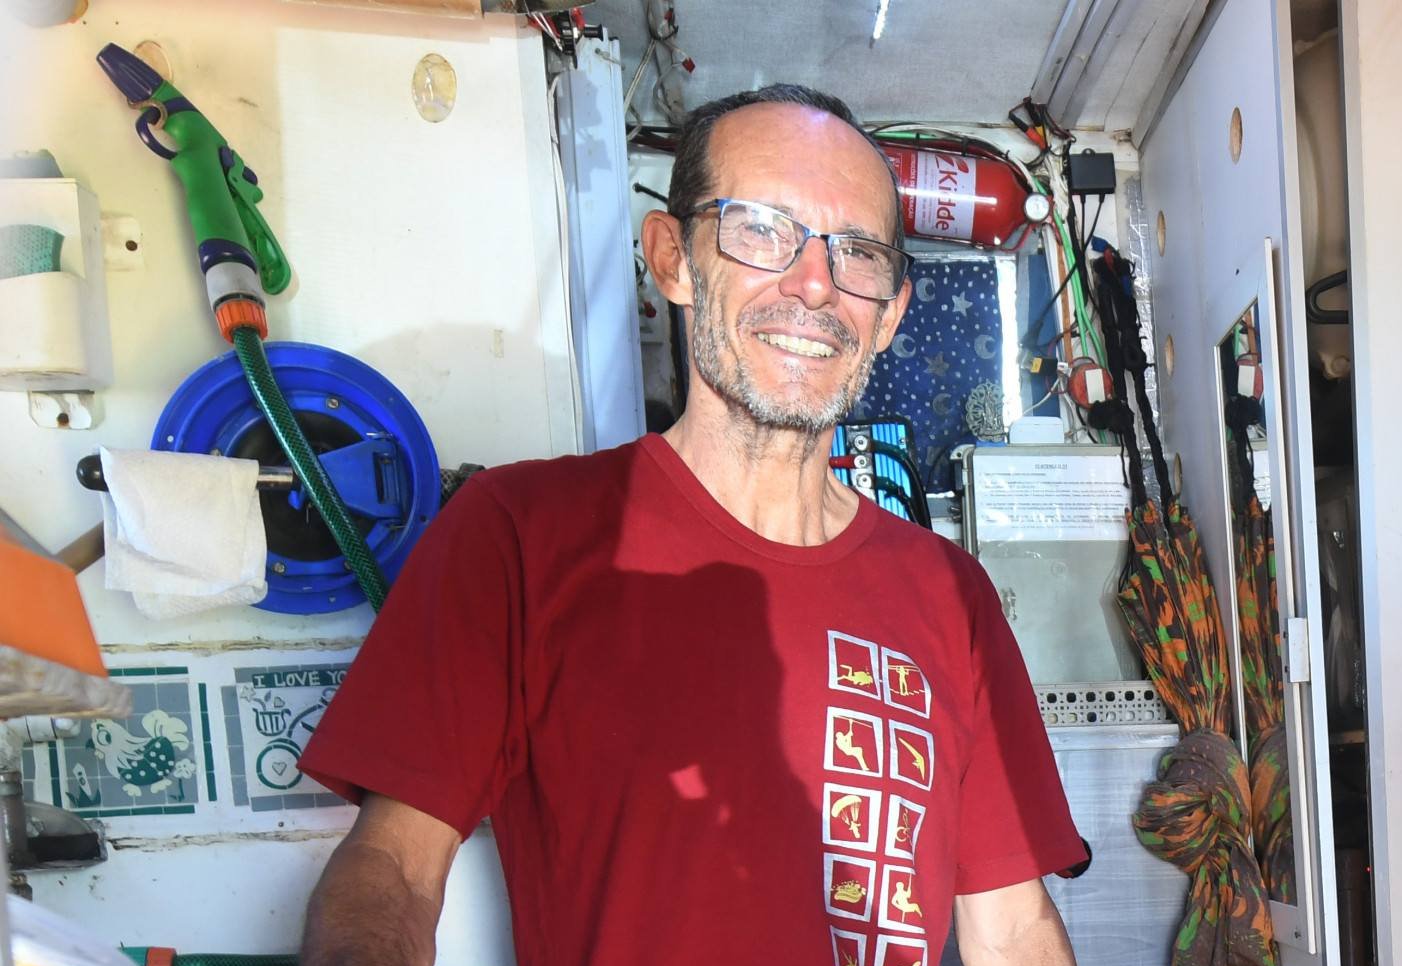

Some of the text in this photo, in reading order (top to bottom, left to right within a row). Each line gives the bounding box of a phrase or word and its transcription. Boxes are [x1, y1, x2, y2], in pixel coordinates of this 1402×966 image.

[935, 169, 958, 231] Kidde
[254, 675, 266, 688] I
[273, 670, 321, 687] LOVE
